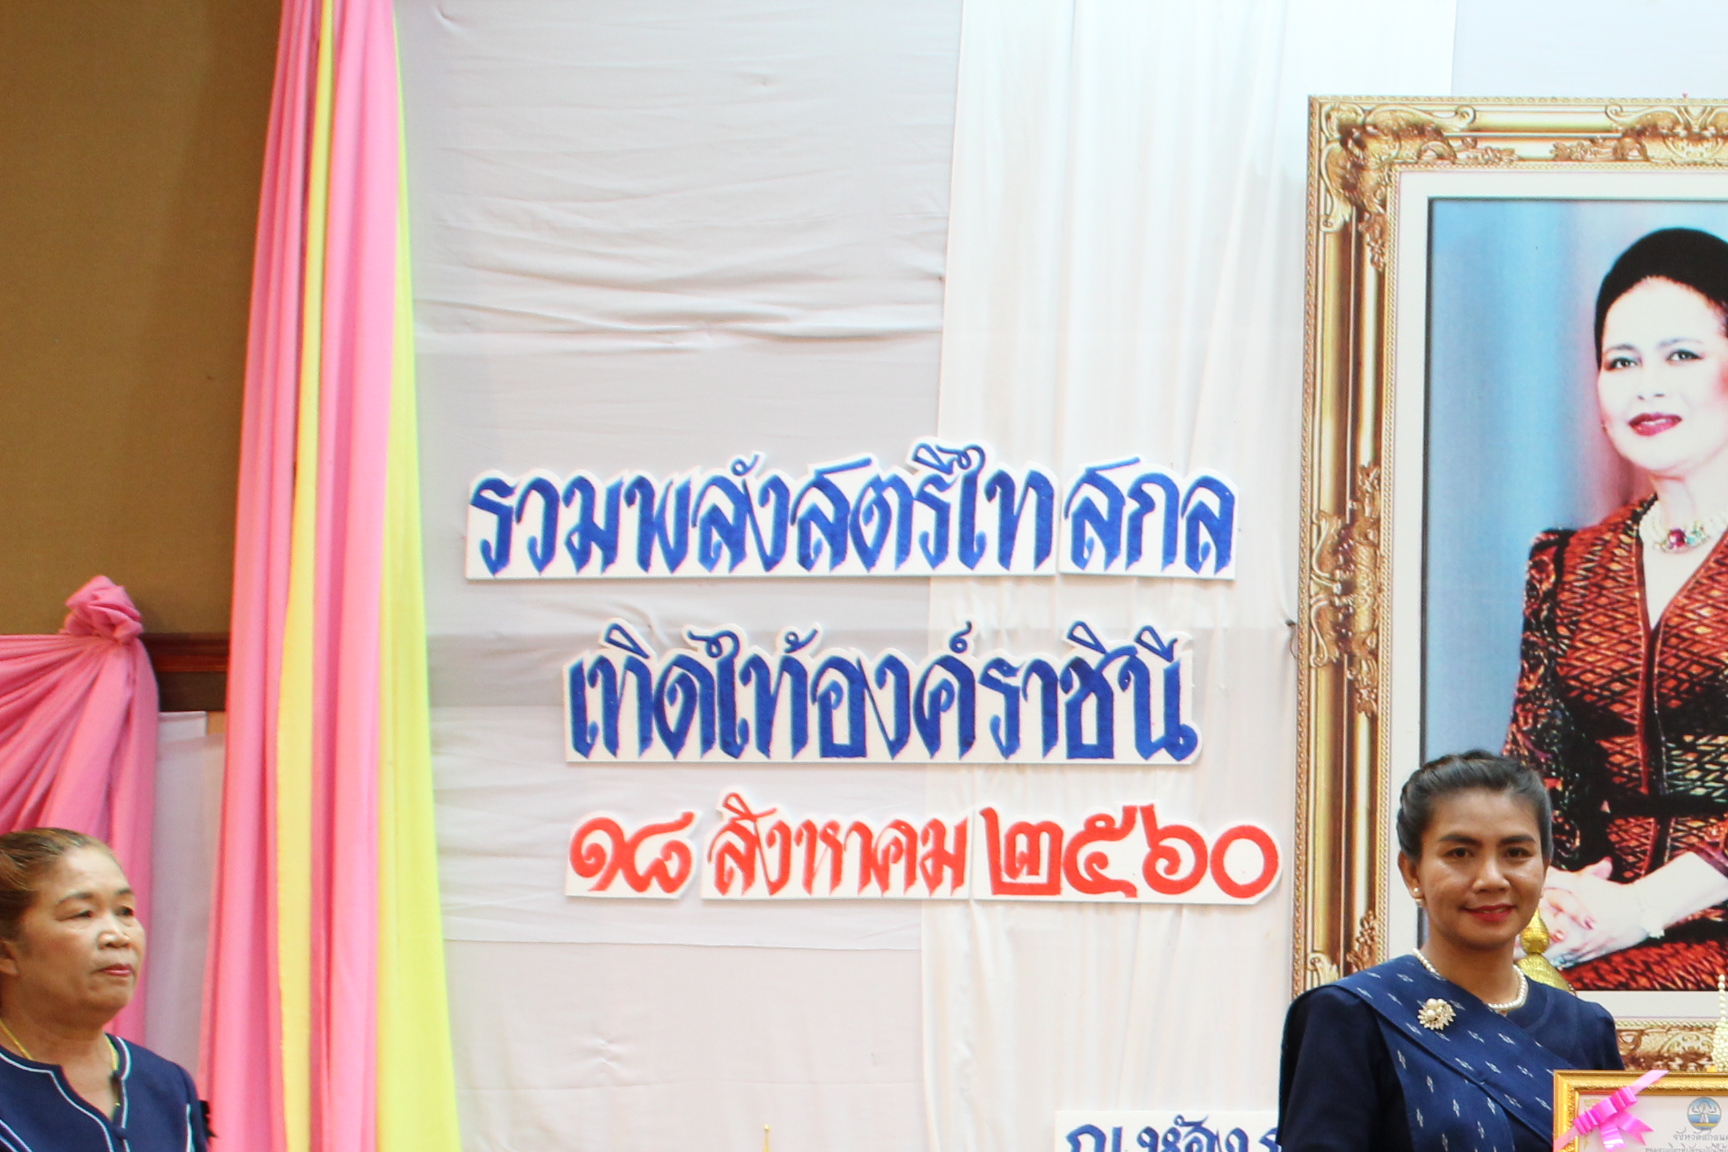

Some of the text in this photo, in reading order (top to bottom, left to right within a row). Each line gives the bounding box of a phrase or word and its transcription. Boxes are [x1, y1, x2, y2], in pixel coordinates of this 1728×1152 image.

[569, 621, 1198, 761] เทิดไท้องค์ราชินี
[571, 793, 1279, 899] ๑๘ สิงหาคม ๒๕๖๐
